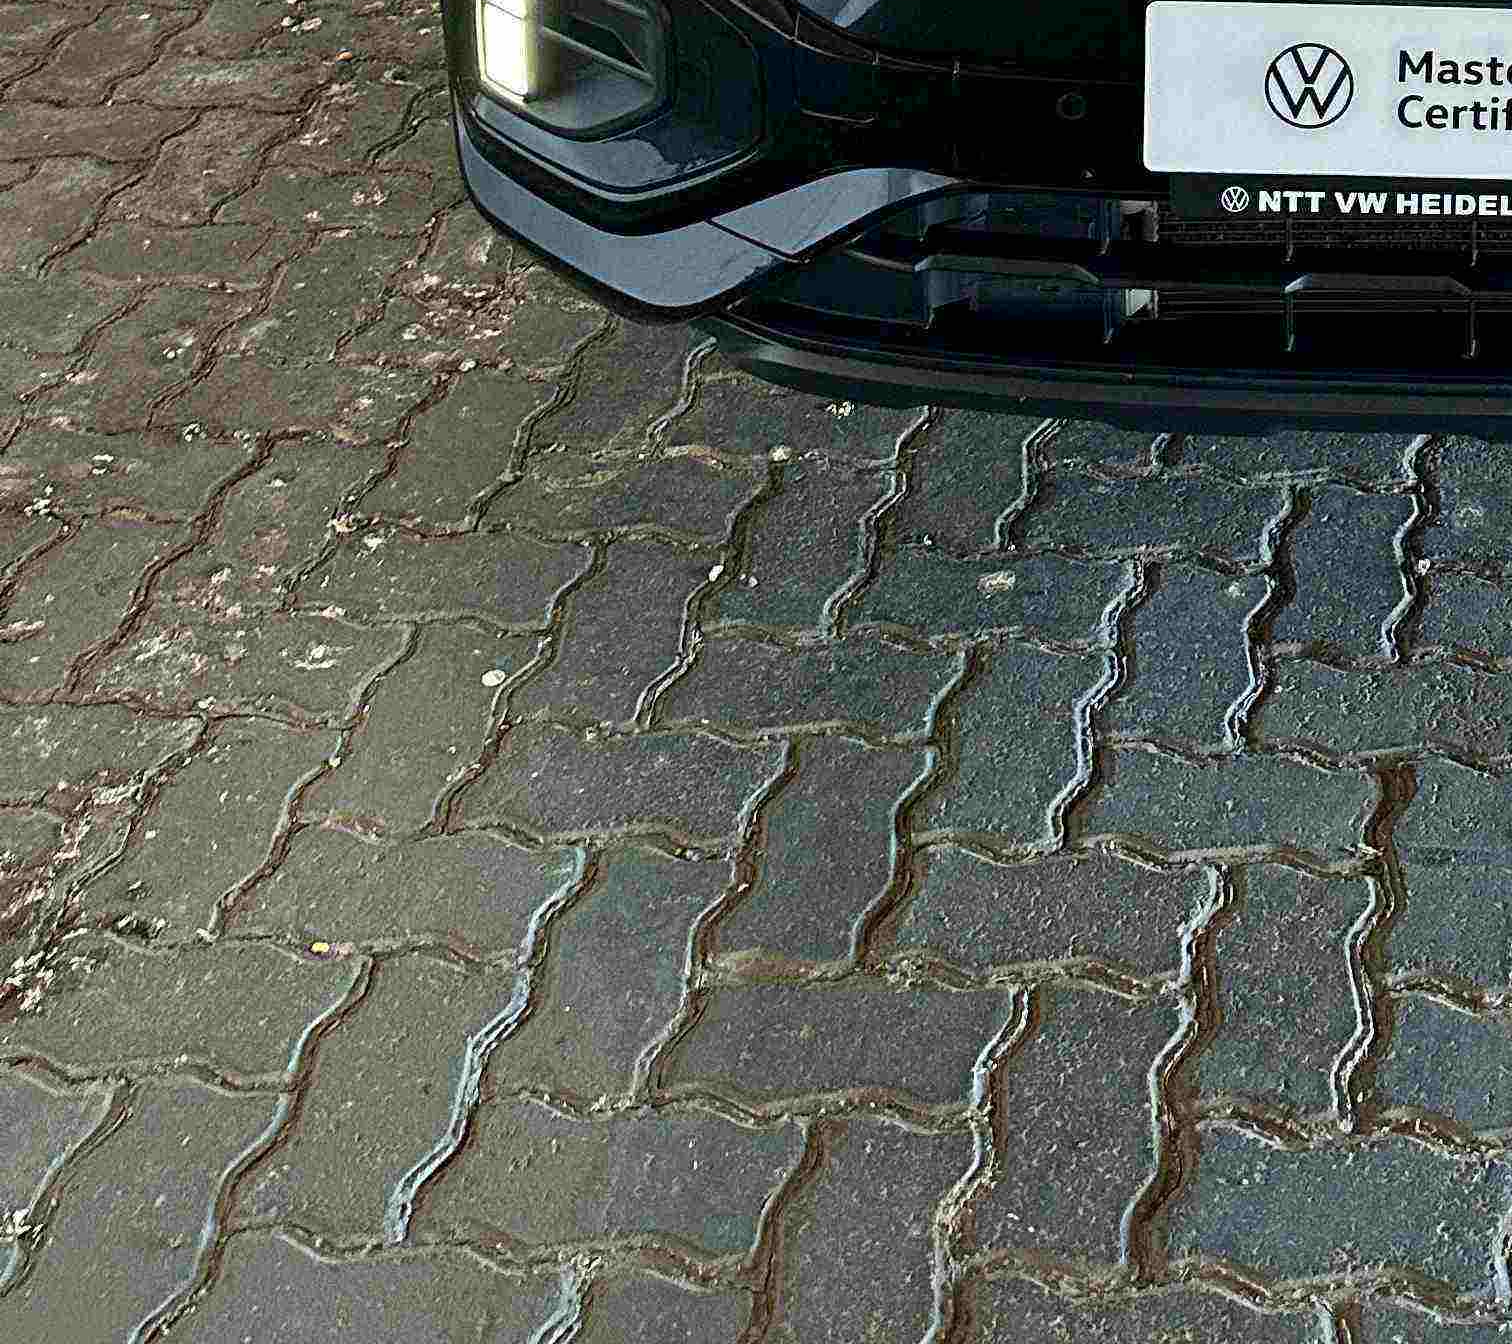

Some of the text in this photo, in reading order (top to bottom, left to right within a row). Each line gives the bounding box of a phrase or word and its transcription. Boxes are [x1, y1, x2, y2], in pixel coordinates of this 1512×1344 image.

[1267, 44, 1351, 125] VW
[1257, 189, 1326, 213] NTT
[1333, 191, 1388, 214] VW
